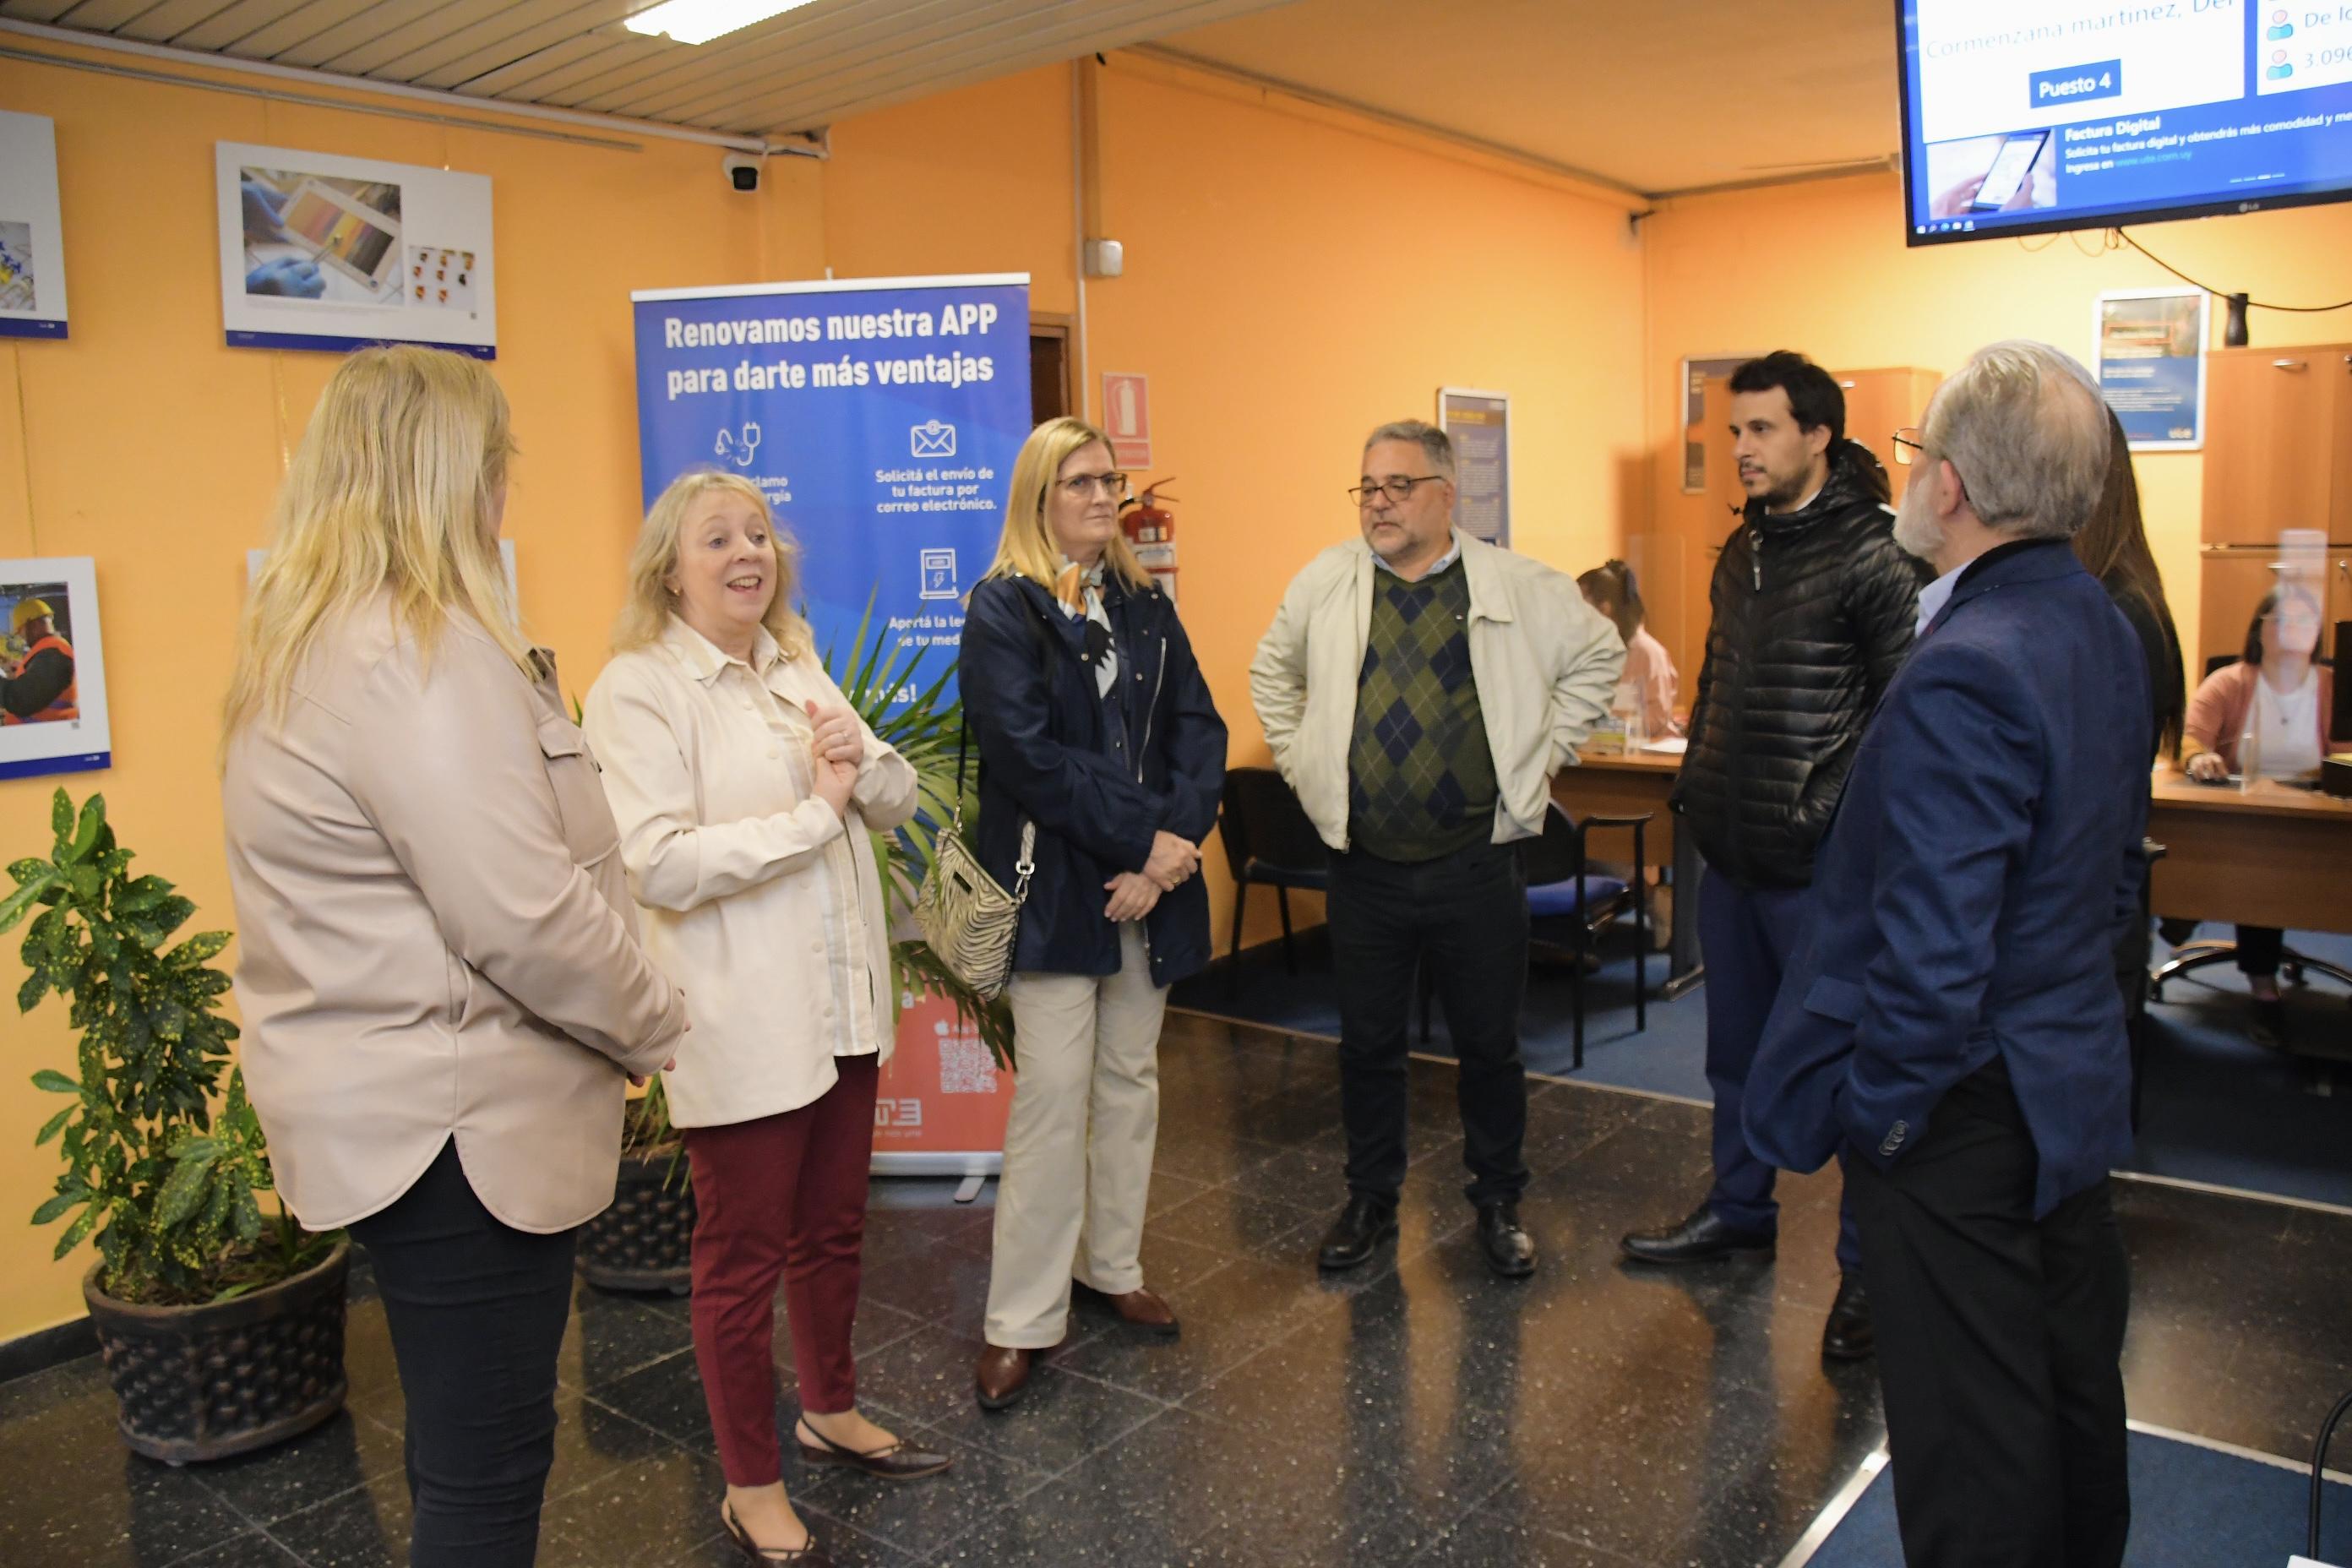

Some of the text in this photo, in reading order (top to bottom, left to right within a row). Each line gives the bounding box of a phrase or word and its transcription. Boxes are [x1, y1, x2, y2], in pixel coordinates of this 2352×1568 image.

[2304, 12, 2332, 28] De
[1926, 22, 2063, 59] Cormenzana
[2039, 71, 2112, 99] Puesto 4
[2065, 115, 2161, 143] Factura Digital
[2099, 144, 2111, 155] tu
[2112, 140, 2146, 153] factura
[2147, 134, 2177, 150] digital
[2178, 135, 2186, 147] y
[2186, 126, 2238, 143] obtendrás
[2239, 122, 2262, 136] más
[2262, 113, 2324, 133] comodidad
[2325, 113, 2333, 127] y
[2100, 160, 2115, 170] en
[665, 302, 999, 348] Renovamos nuestra APP
[667, 351, 995, 401] para darte más ventajas
[875, 466, 994, 482] Solicitá el envío de
[891, 483, 980, 498] tu factura por
[875, 497, 998, 514] correo electrónico.
[934, 615, 947, 629] la
[915, 634, 930, 646] tu
[932, 633, 961, 646] med
